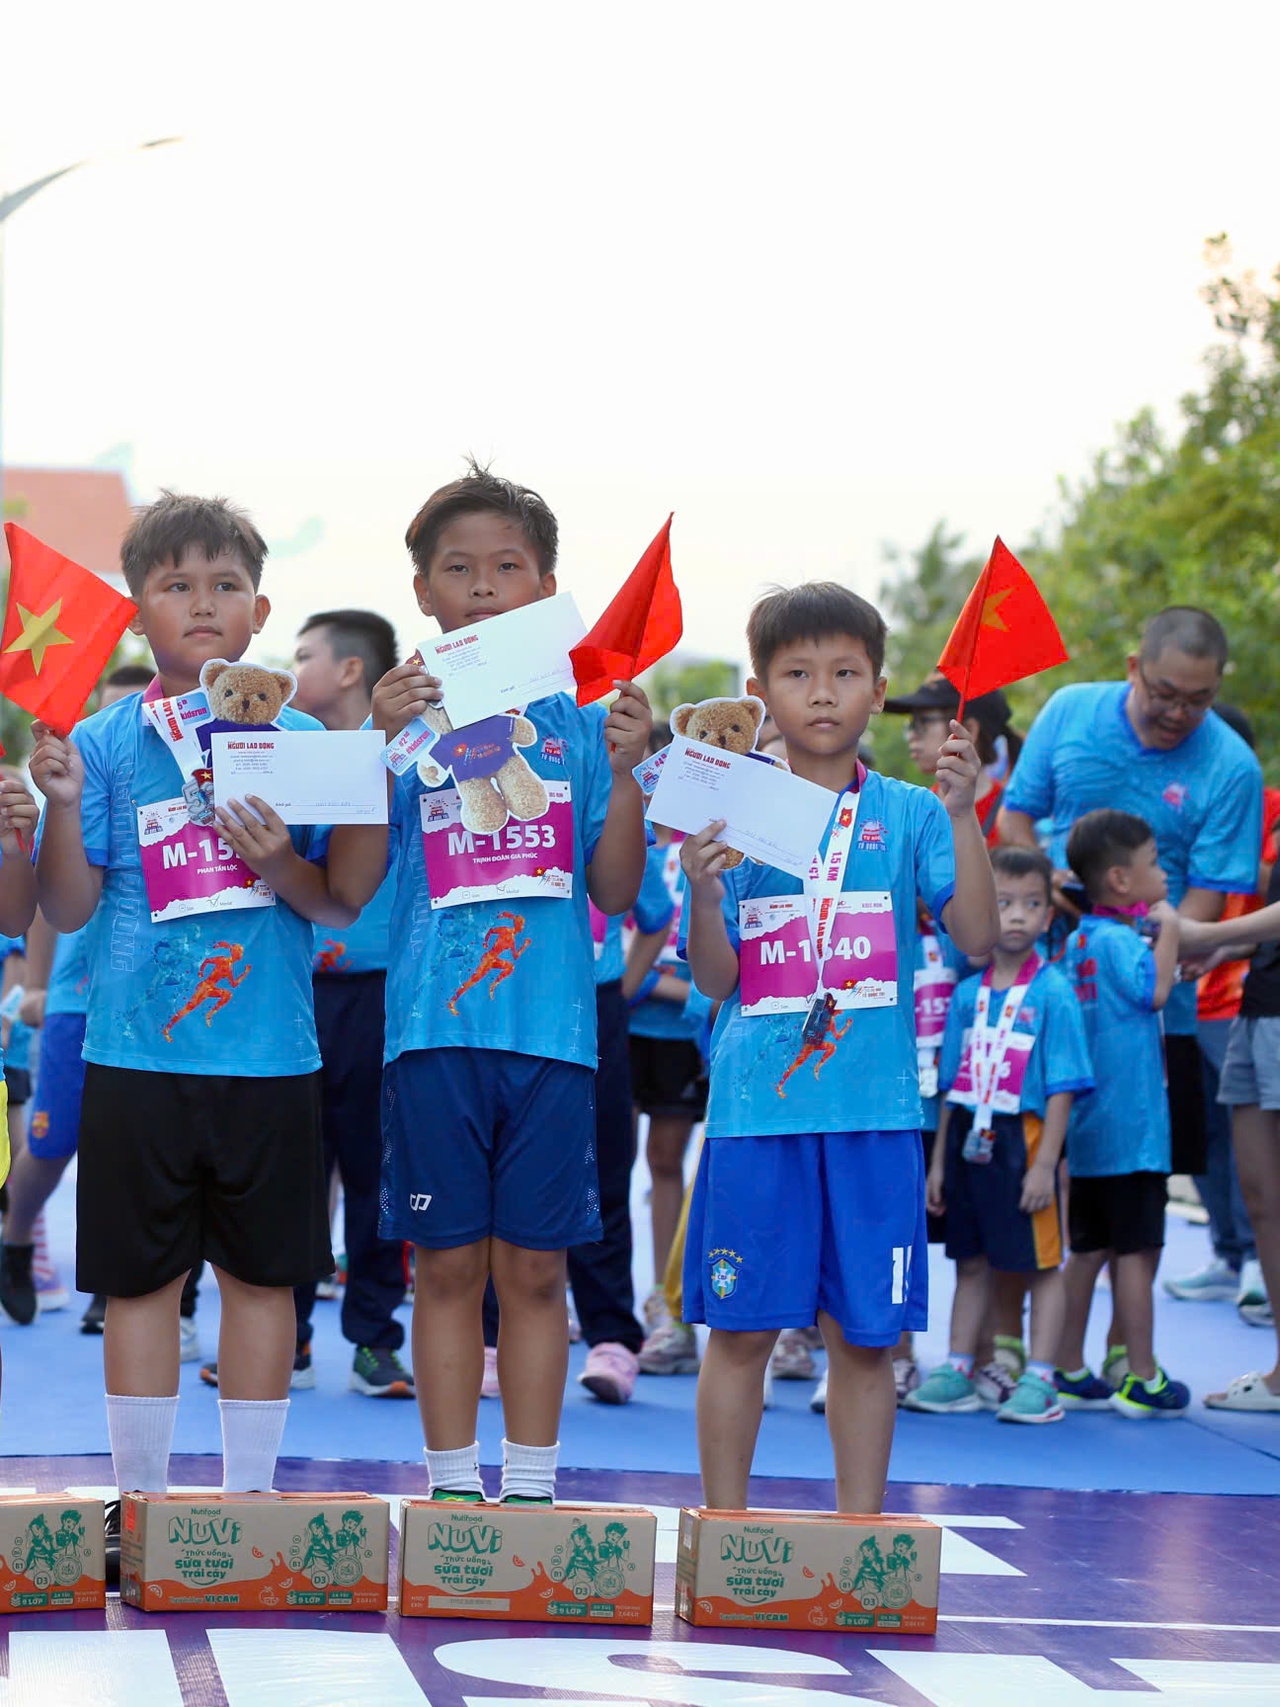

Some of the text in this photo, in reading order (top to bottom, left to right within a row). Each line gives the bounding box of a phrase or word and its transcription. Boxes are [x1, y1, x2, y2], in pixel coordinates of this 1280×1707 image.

[180, 707, 208, 720] kidsrun
[246, 742, 258, 750] LAO
[702, 754, 714, 764] LAO
[448, 824, 556, 856] M-1553
[162, 837, 241, 870] M-15
[826, 866, 840, 882] KM
[190, 1508, 222, 1517] Nutifood
[450, 1514, 482, 1523] Nutifood
[36, 1576, 48, 1586] D3
[314, 1575, 326, 1584] D3
[576, 1586, 588, 1596] D3
[216, 1595, 239, 1603] CAM
[864, 1598, 876, 1607] D3
[766, 1613, 789, 1622] CAM
